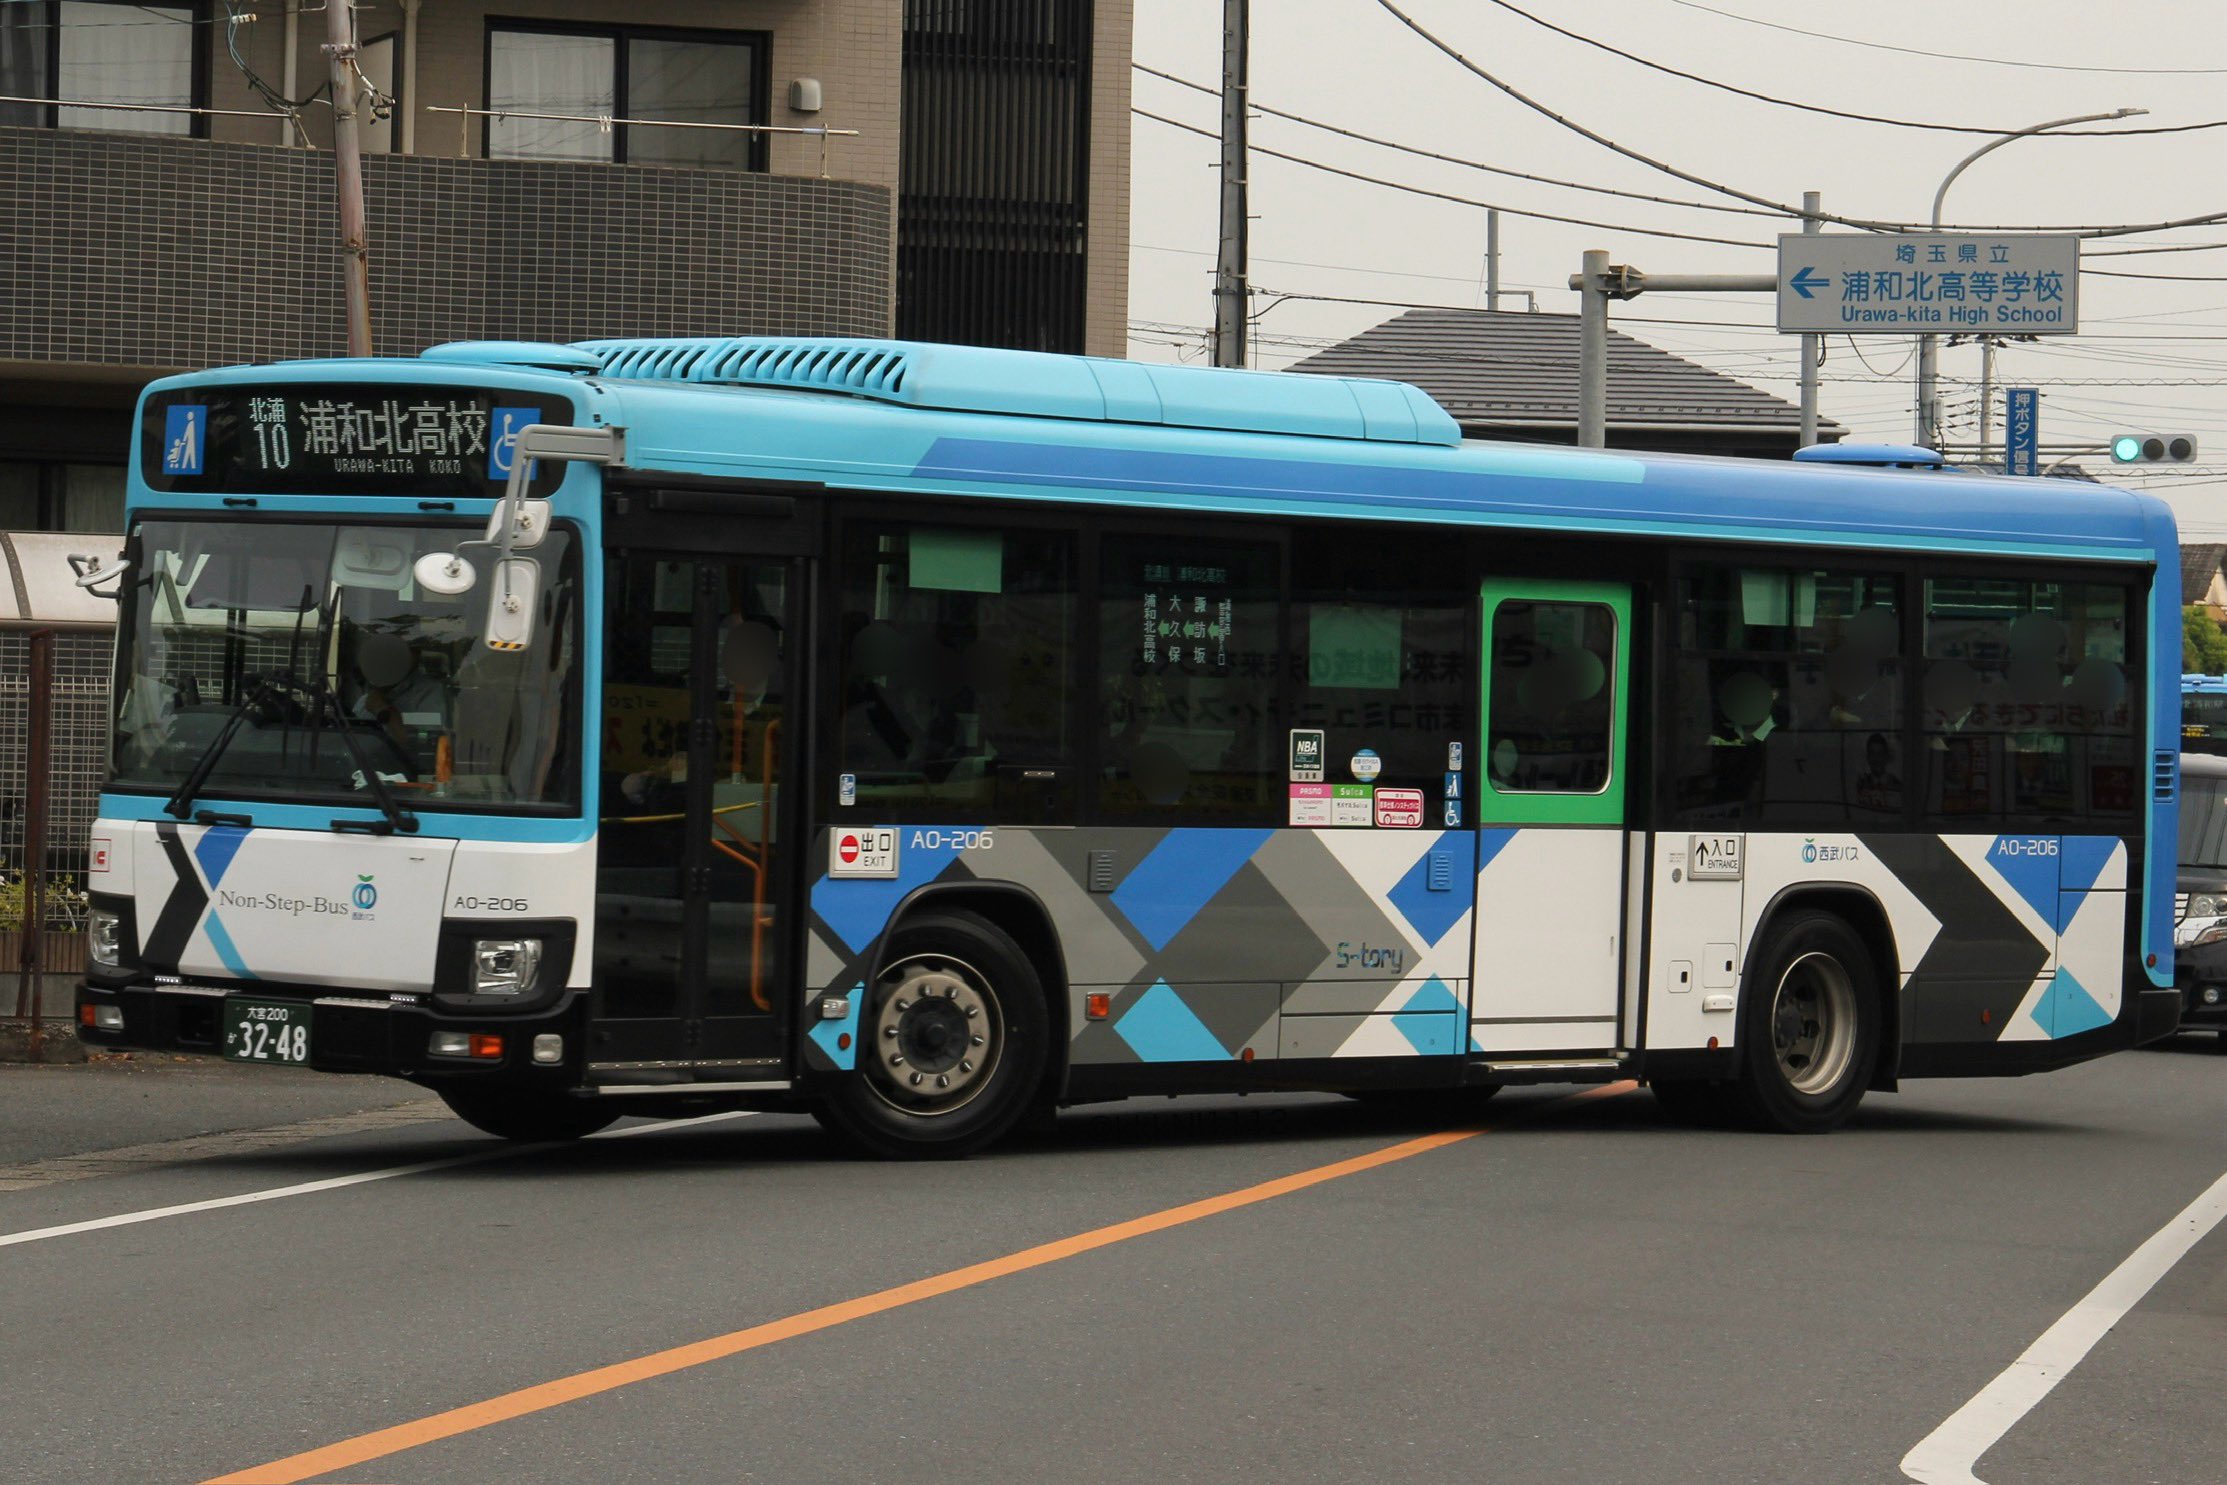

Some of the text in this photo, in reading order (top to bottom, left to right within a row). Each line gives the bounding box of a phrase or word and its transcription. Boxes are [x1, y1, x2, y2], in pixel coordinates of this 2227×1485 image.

[1895, 243, 2010, 264] 埼玉県立
[1841, 270, 2064, 303] 浦和北高等学校
[1842, 305, 2062, 326] Urawa-kita High School
[249, 398, 286, 423] 北浦
[300, 400, 486, 455] 浦和北高校
[253, 423, 290, 469] 10
[334, 458, 415, 473] URAWA-KITA
[1143, 593, 1157, 663] 浦和北高校
[1168, 595, 1182, 663] 大久保
[1297, 741, 1318, 753] NBA
[1340, 787, 1364, 796] Suica
[861, 832, 891, 852] 出口
[1711, 839, 1736, 856] 入口
[863, 855, 887, 867] EXIT
[1707, 859, 1738, 869] ENTRANCE
[1819, 846, 1859, 861] 西武バス
[219, 890, 349, 916] Non-Step-Bus
[1336, 942, 1403, 974] S-tory
[238, 1021, 307, 1061] 32-48
